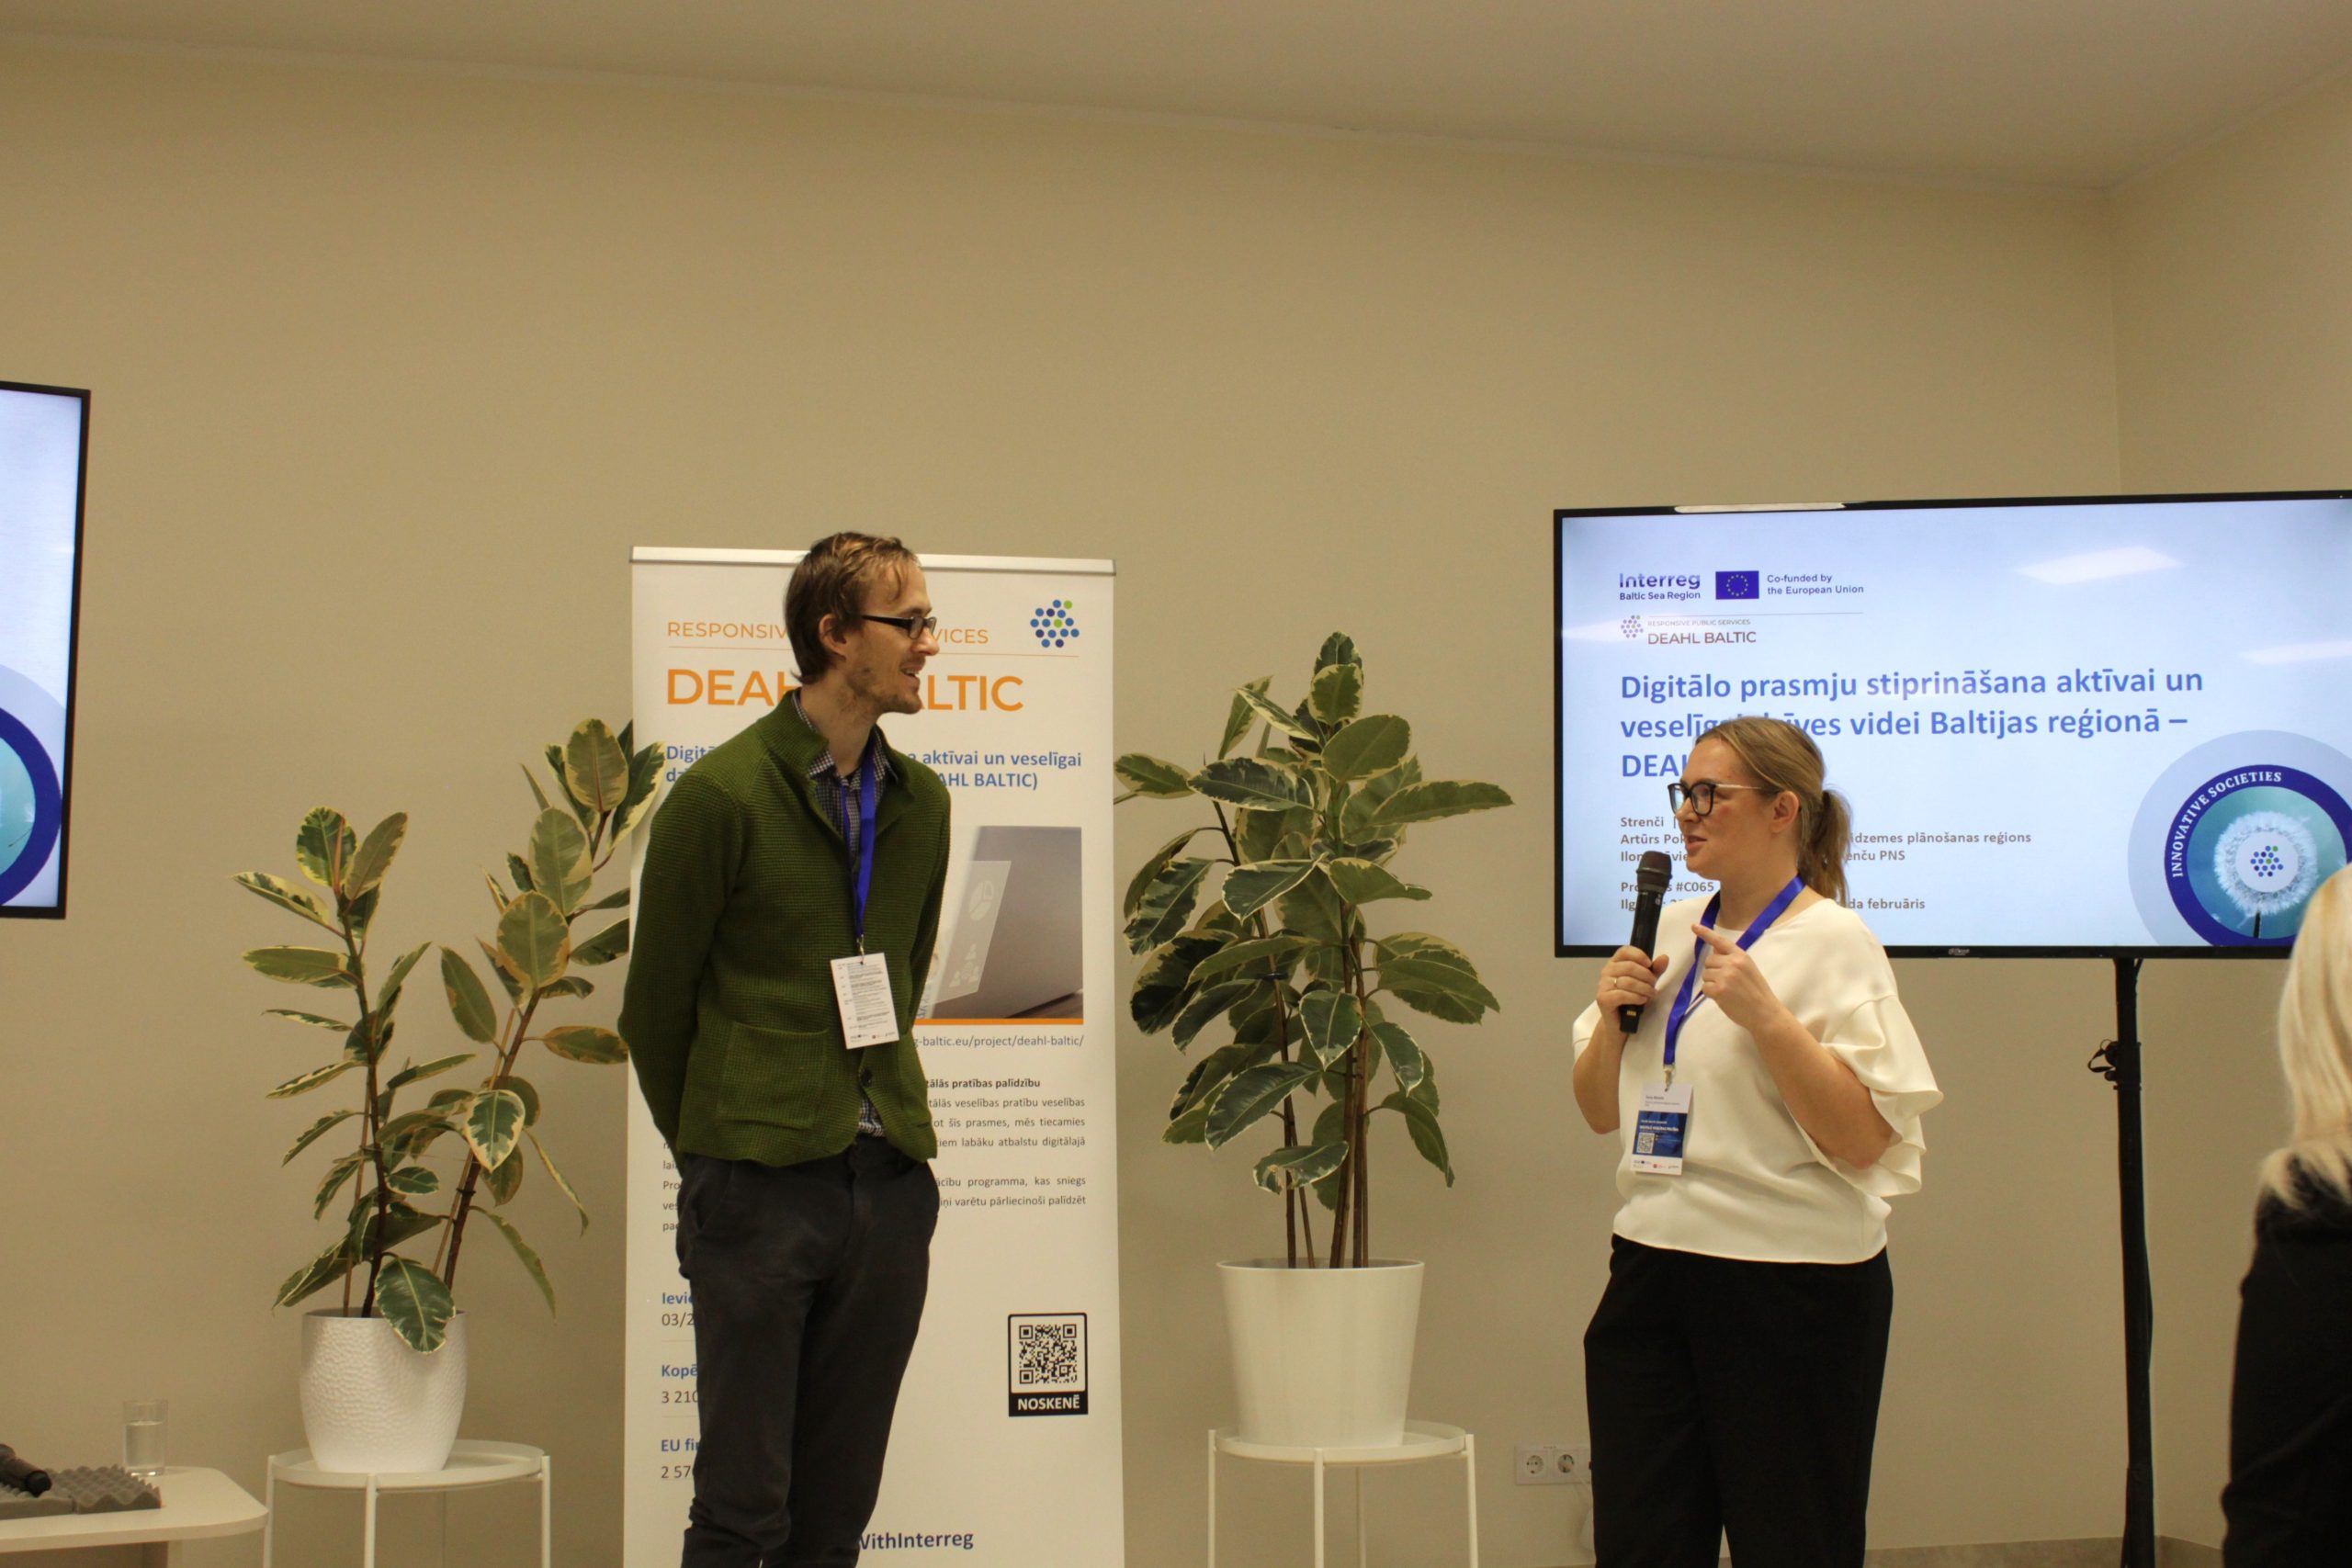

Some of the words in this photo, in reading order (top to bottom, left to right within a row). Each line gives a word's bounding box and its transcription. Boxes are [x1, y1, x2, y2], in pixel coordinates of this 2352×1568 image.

[1619, 572, 1701, 590] Interreg
[1767, 573, 1818, 583] Co-funded
[1820, 573, 1833, 584] by
[1620, 592, 1646, 601] Baltic
[1647, 592, 1666, 600] Sea
[1667, 591, 1701, 602] Region
[1767, 586, 1783, 595] the
[1785, 585, 1833, 596] European
[1835, 584, 1864, 594] Union
[667, 622, 788, 639] RESPONSIV
[933, 628, 989, 644] VICES
[1647, 632, 1701, 645] DEAHL
[1704, 631, 1757, 644] BALTIC
[667, 669, 802, 706] DEAH
[1621, 673, 1732, 704] Digitālo
[1741, 672, 1857, 703] prasmju
[1866, 669, 2047, 700] stiprināšana
[2056, 668, 2155, 693] aktīvai
[2165, 671, 2203, 692] un
[921, 675, 1023, 712] LTIC
[1849, 711, 1920, 735] videi
[1930, 710, 2038, 739] Baltijas
[2048, 707, 2160, 739] reģionā
[666, 745, 715, 763] Digit
[922, 750, 978, 765] aktīvai
[984, 754, 1005, 765] un
[1011, 751, 1081, 770] veselīgai
[1622, 754, 1687, 777] DEA
[936, 773, 969, 787] AHL
[974, 773, 1038, 791] BALTIC)
[1620, 816, 1665, 828] Strenči
[2171, 794, 2211, 877] INNOVATIVE
[2207, 771, 2282, 798] SOCIETIES
[1620, 834, 1660, 844] Artūrs
[1850, 831, 1904, 843] idzemes
[1906, 831, 1980, 845] plānošanas
[1984, 830, 2032, 845] reģions
[1846, 850, 1876, 861] enču
[1880, 850, 1906, 862] PNS
[1675, 881, 1715, 892] #C065
[1868, 897, 1926, 909] februāris
[952, 1078, 993, 1090] pratības
[995, 1077, 1041, 1089] palīdzību
[929, 1098, 952, 1108] tālās
[955, 1098, 1000, 1108] veselības
[1002, 1098, 1038, 1111] pratību
[1041, 1097, 1086, 1108] veselības
[948, 1118, 961, 1128] šīs
[966, 1119, 1011, 1129] prasmes,
[1014, 1117, 1035, 1127] mēs
[1039, 1117, 1086, 1127] tiecamies
[961, 1138, 994, 1147] labāku
[998, 1137, 1038, 1146] atbalstu
[1042, 1136, 1086, 1148] digitālajā
[662, 1180, 682, 1190] Pro
[937, 1178, 961, 1187] ācību
[967, 1178, 1029, 1189] programma,
[1035, 1176, 1051, 1186] kas
[1057, 1177, 1086, 1188] sniegs
[940, 1197, 952, 1209] iņi
[955, 1196, 987, 1206] varētu
[989, 1195, 1046, 1208] pārliecinoši
[1048, 1195, 1086, 1207] palīdzēt
[662, 1312, 695, 1328] 03/2
[662, 1364, 698, 1380] Kopē
[661, 1390, 670, 1404] 3
[1017, 1393, 1080, 1411] NOSKENĒ
[661, 1438, 680, 1452] EU
[661, 1465, 670, 1479] 2
[674, 1465, 692, 1479] 57
[860, 1532, 974, 1551] ithInterreg
